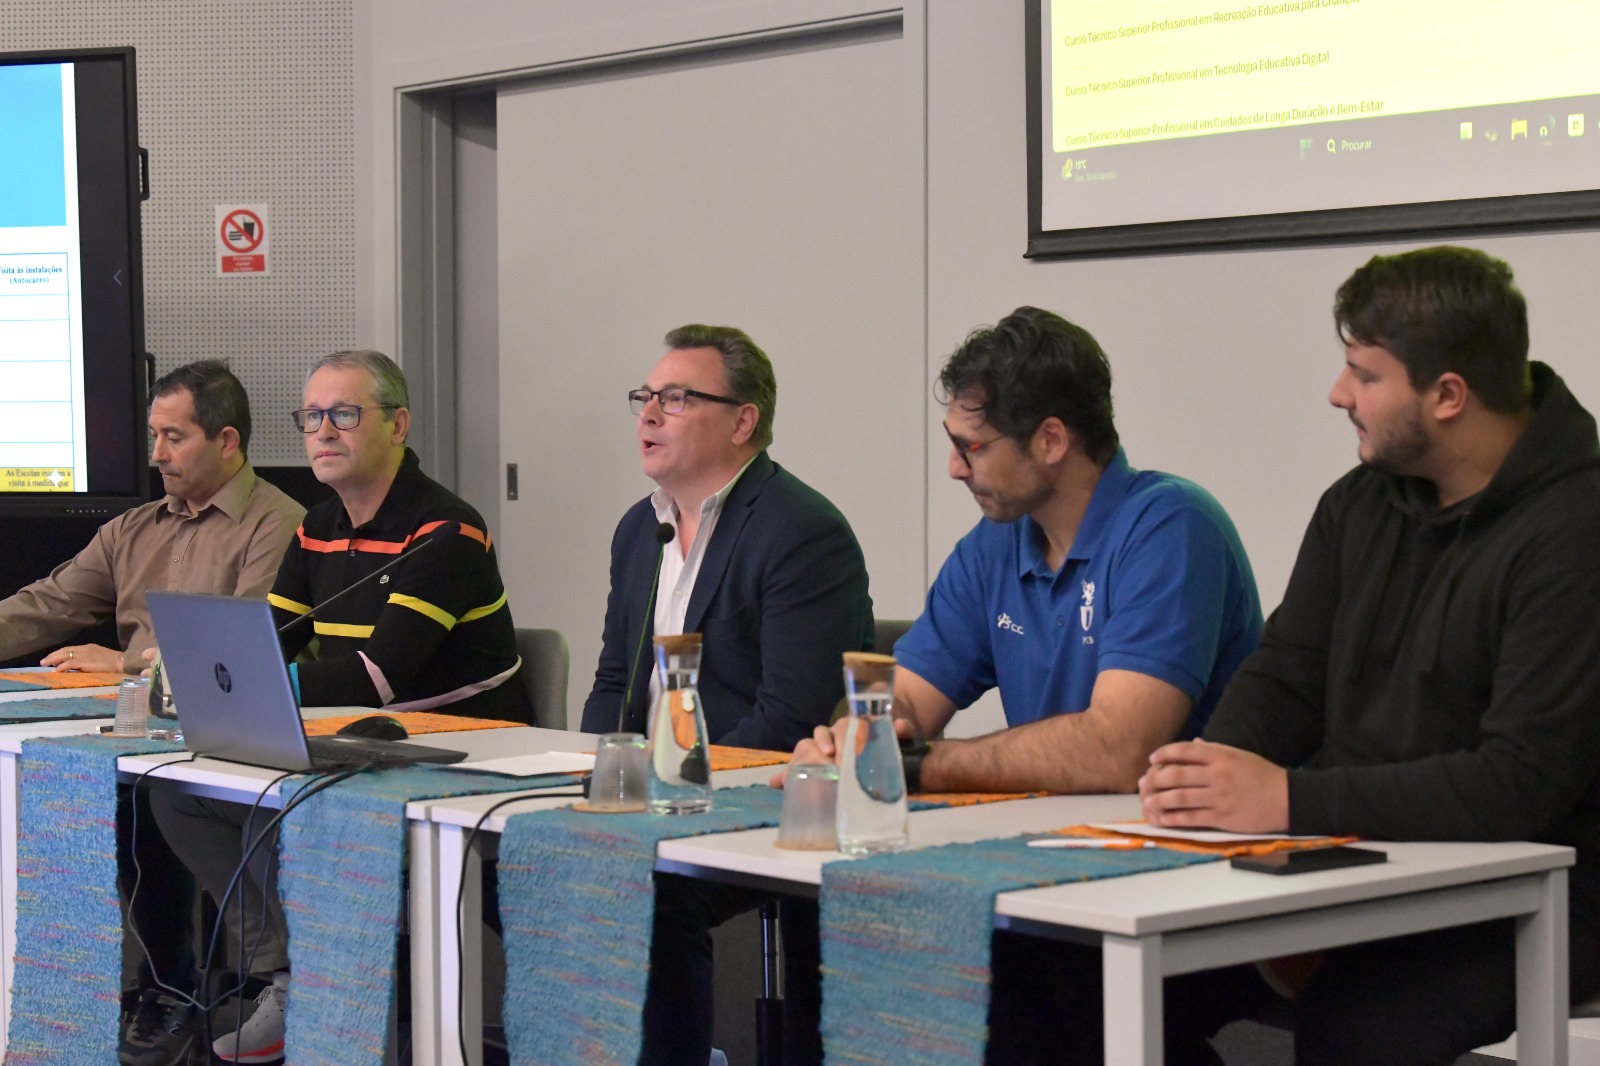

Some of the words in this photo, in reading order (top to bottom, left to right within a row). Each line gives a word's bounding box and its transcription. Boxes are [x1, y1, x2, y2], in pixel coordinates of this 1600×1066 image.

[1065, 34, 1087, 47] Curso
[1088, 30, 1117, 43] Técnico
[1118, 25, 1150, 39] Superior
[1151, 16, 1198, 32] Profissional
[1199, 15, 1212, 25] em
[1213, 7, 1257, 23] Recreação
[1258, 0, 1300, 17] Educativa
[1301, 0, 1320, 12] para
[1065, 86, 1087, 97] Curso
[1088, 81, 1118, 93] Técnico
[1118, 76, 1151, 89] Superior
[1152, 68, 1198, 84] Profissional
[1199, 68, 1213, 78] em
[1214, 62, 1258, 76] Tecnologia
[1259, 55, 1301, 71] Educativa
[1302, 51, 1330, 67] Digital
[1065, 134, 1087, 146] Curso
[1088, 130, 1118, 143] Técnico
[1118, 126, 1151, 139] Superior
[1152, 119, 1198, 135] Profissional
[1199, 119, 1213, 130] em
[1213, 113, 1253, 128] Cuidados
[1253, 112, 1264, 124] de
[1265, 110, 1291, 124] Longa
[1292, 104, 1329, 120] Duração
[1329, 106, 1336, 115] e
[1337, 99, 1385, 115] Bem-Estar
[1341, 139, 1372, 152] Procurar
[0, 266, 15, 274] isita
[17, 265, 24, 274] às
[26, 265, 63, 275] instalações
[9, 276, 50, 285] (Autocarro)
[6, 469, 15, 477] As
[16, 469, 41, 477] Escolas
[57, 481, 69, 489] que
[216, 663, 231, 693] hp
